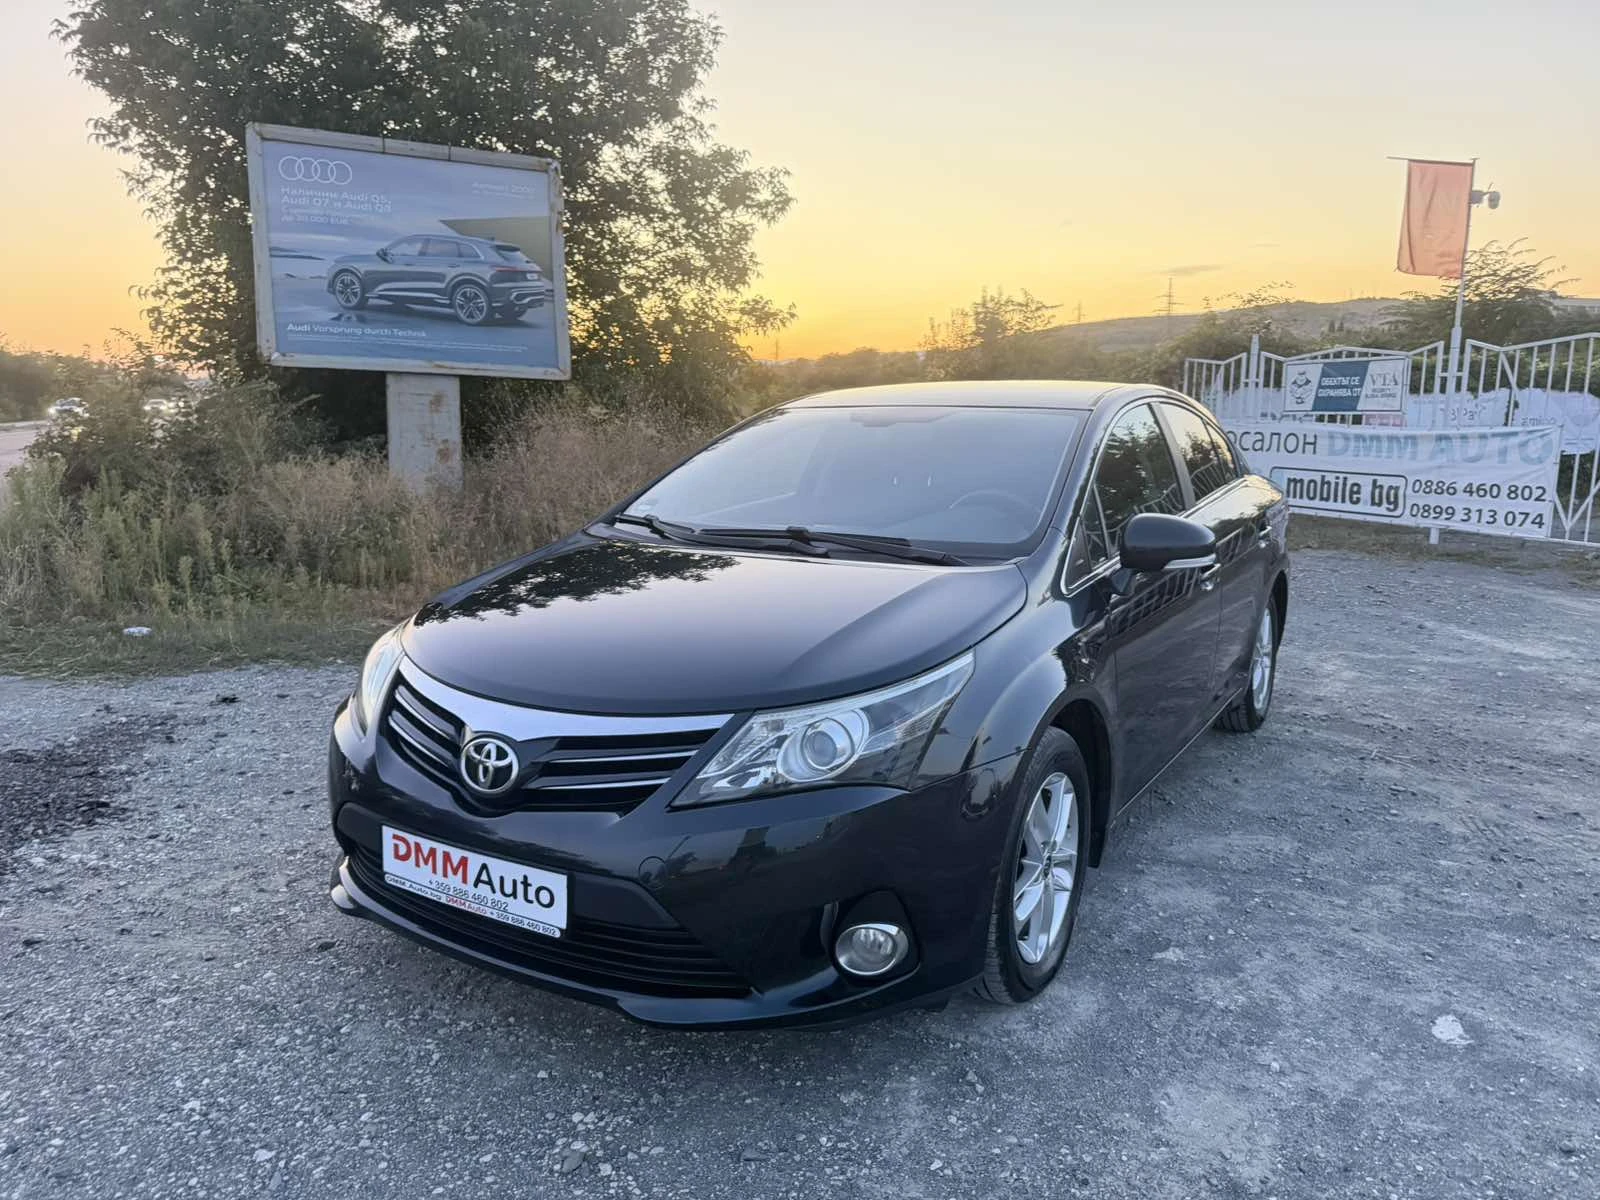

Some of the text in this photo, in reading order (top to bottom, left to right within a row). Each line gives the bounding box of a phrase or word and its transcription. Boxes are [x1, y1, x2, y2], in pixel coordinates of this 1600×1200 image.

[281, 195, 309, 205] Audi
[344, 201, 371, 210] Audi
[342, 191, 368, 201] Audi
[287, 323, 426, 338] Audi Vorsprung durch Technik
[1327, 431, 1419, 459] DMM
[1433, 430, 1554, 465] AUTO
[1411, 479, 1546, 502] 0886 460 802
[1410, 503, 1545, 529] 0899 313 074
[490, 898, 509, 911] 802
